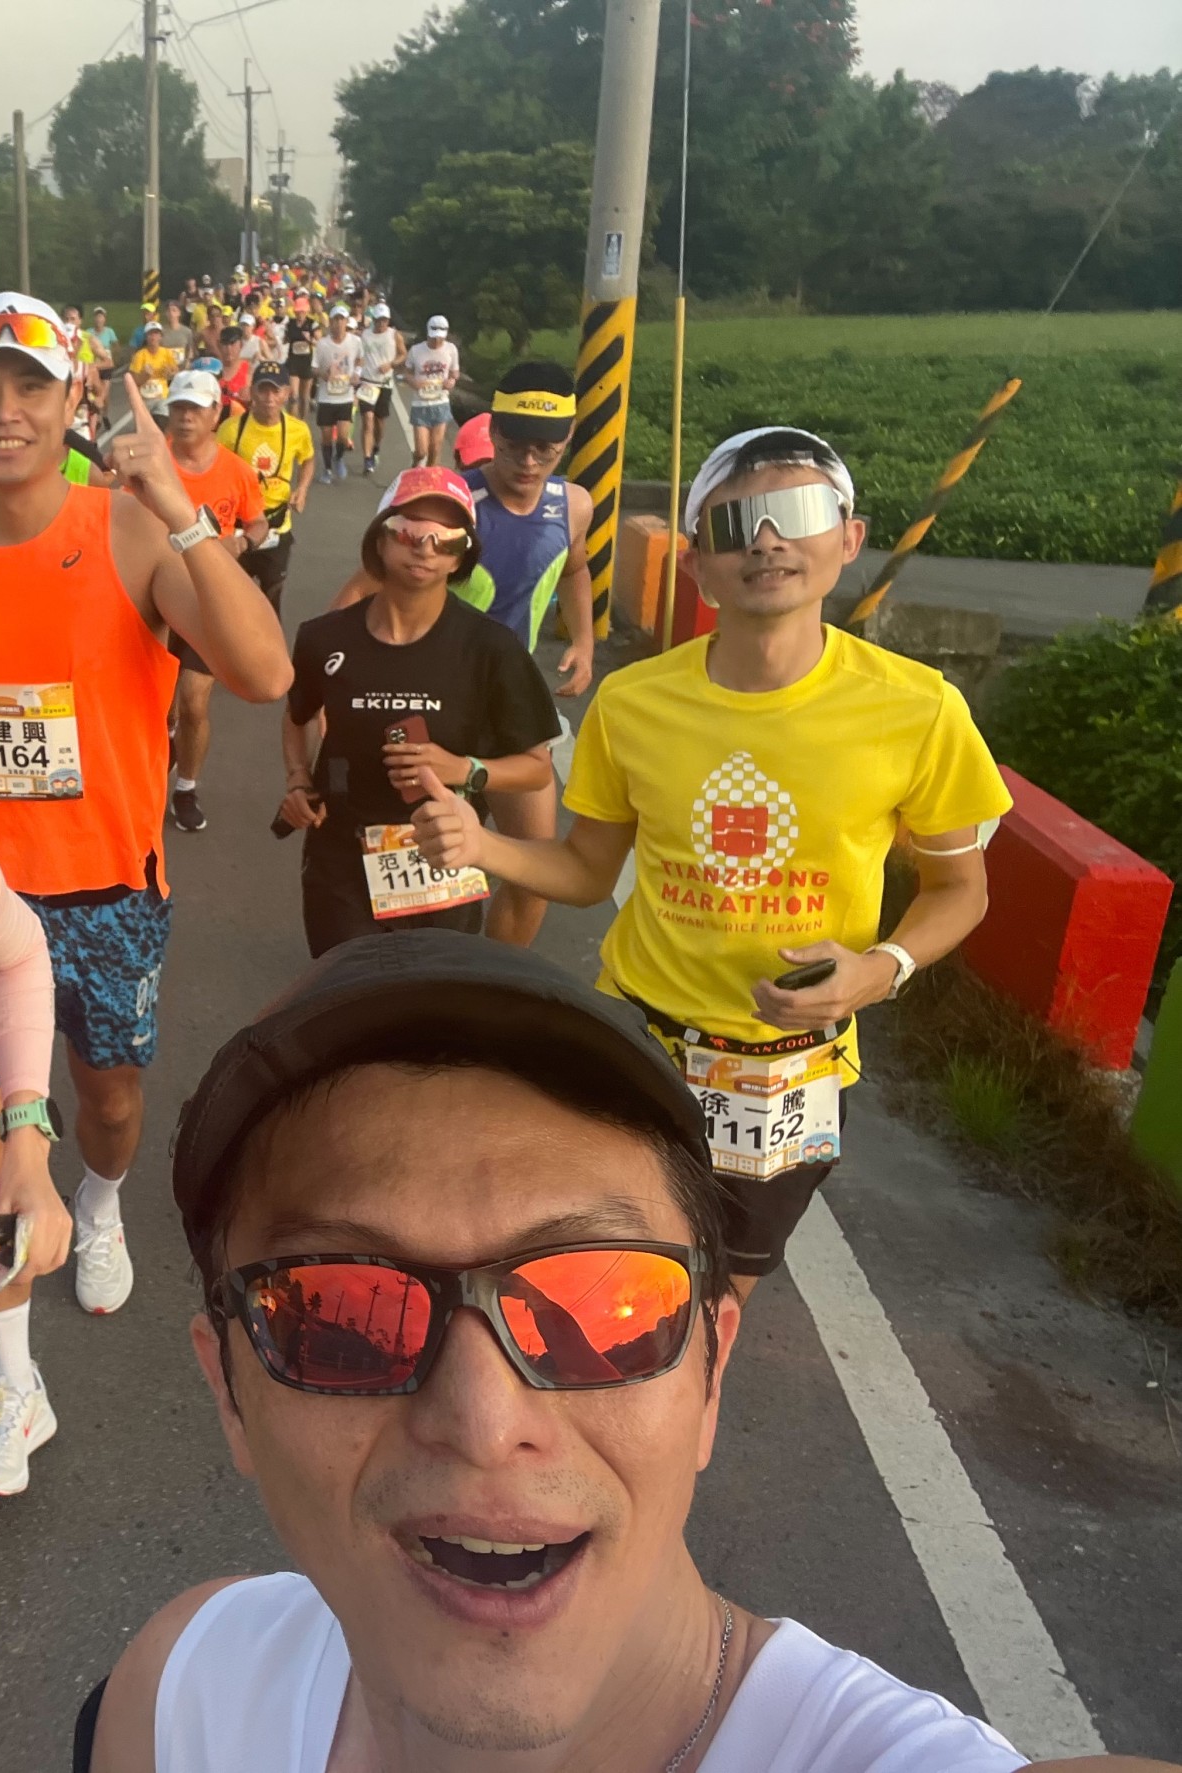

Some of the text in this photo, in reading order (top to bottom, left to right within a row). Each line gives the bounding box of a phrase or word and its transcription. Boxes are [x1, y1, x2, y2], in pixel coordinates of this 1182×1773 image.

[351, 698, 441, 711] EKIDEN
[661, 860, 830, 888] TIANZHONG
[661, 883, 825, 917] MARATHON
[724, 922, 759, 934] RICE
[766, 919, 822, 935] HEAVEN
[776, 1034, 815, 1051] COOL
[706, 1113, 804, 1149] 11152
